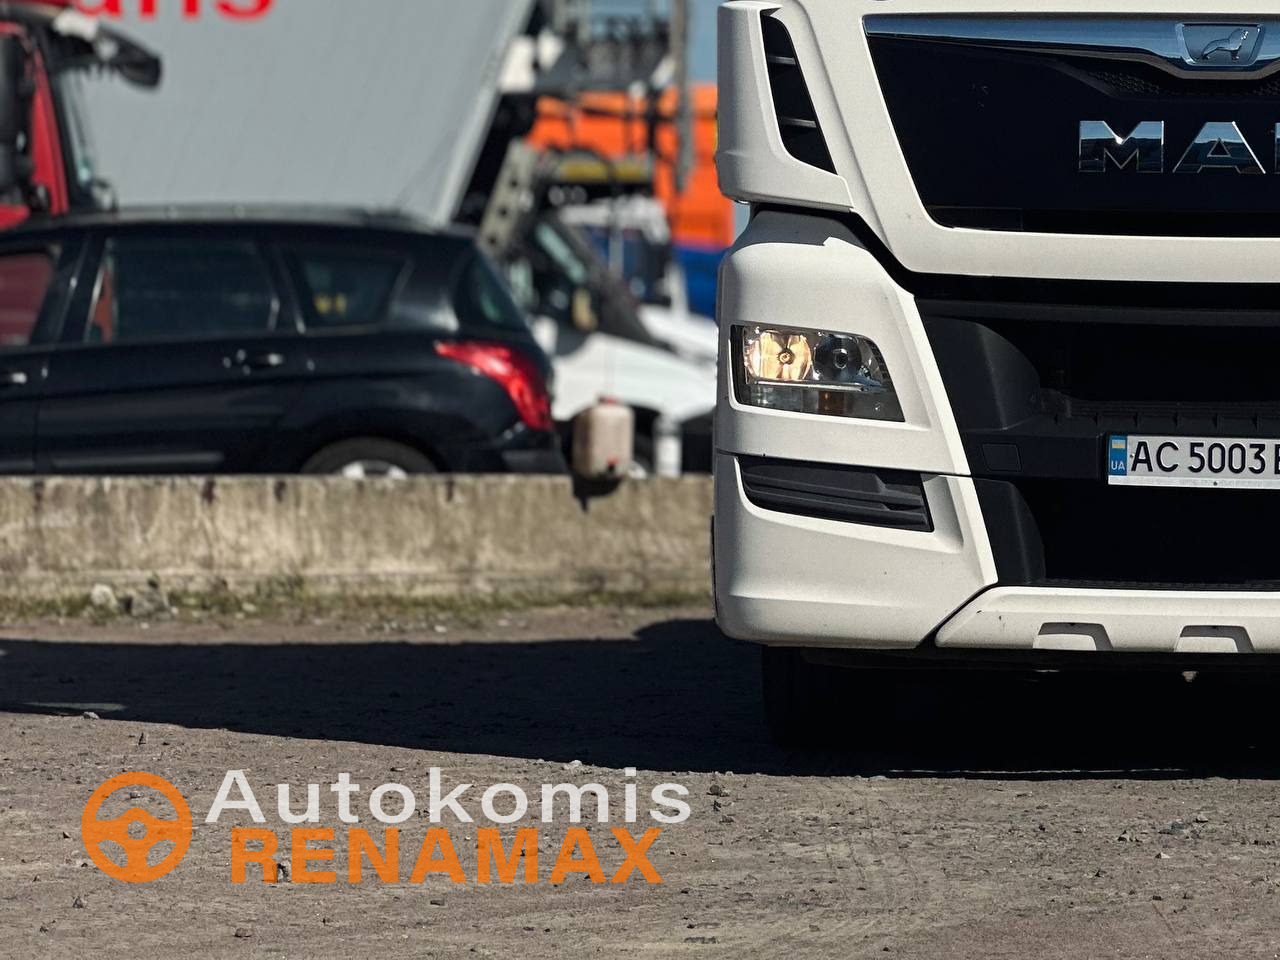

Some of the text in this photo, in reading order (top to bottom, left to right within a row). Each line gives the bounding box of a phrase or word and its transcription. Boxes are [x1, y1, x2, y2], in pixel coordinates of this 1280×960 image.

[1111, 460, 1126, 471] UA
[1130, 441, 1179, 473] AC
[1188, 442, 1266, 474] 5003
